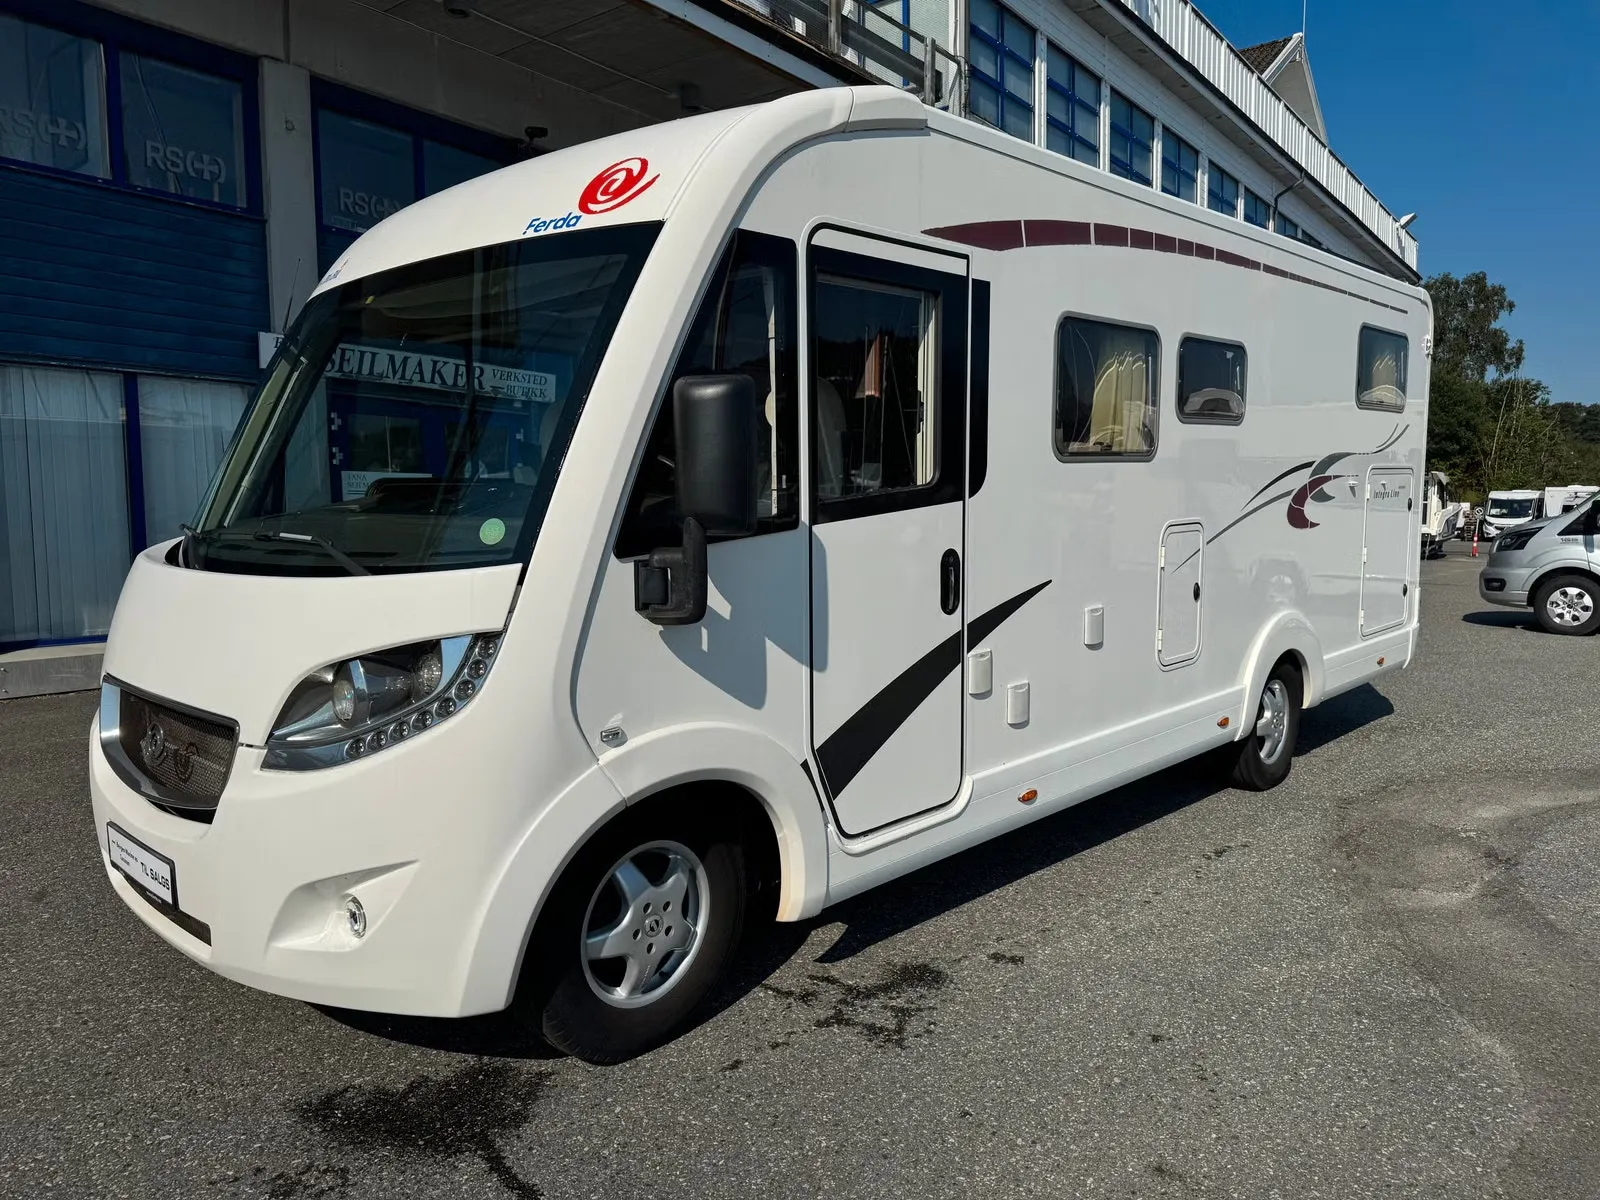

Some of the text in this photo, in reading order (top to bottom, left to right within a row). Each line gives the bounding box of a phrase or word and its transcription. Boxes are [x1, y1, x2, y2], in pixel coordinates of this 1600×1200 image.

[522, 211, 582, 236] Ferda
[492, 368, 548, 386] VERKSTED
[140, 861, 149, 877] TIL
[149, 867, 170, 891] SALGS
